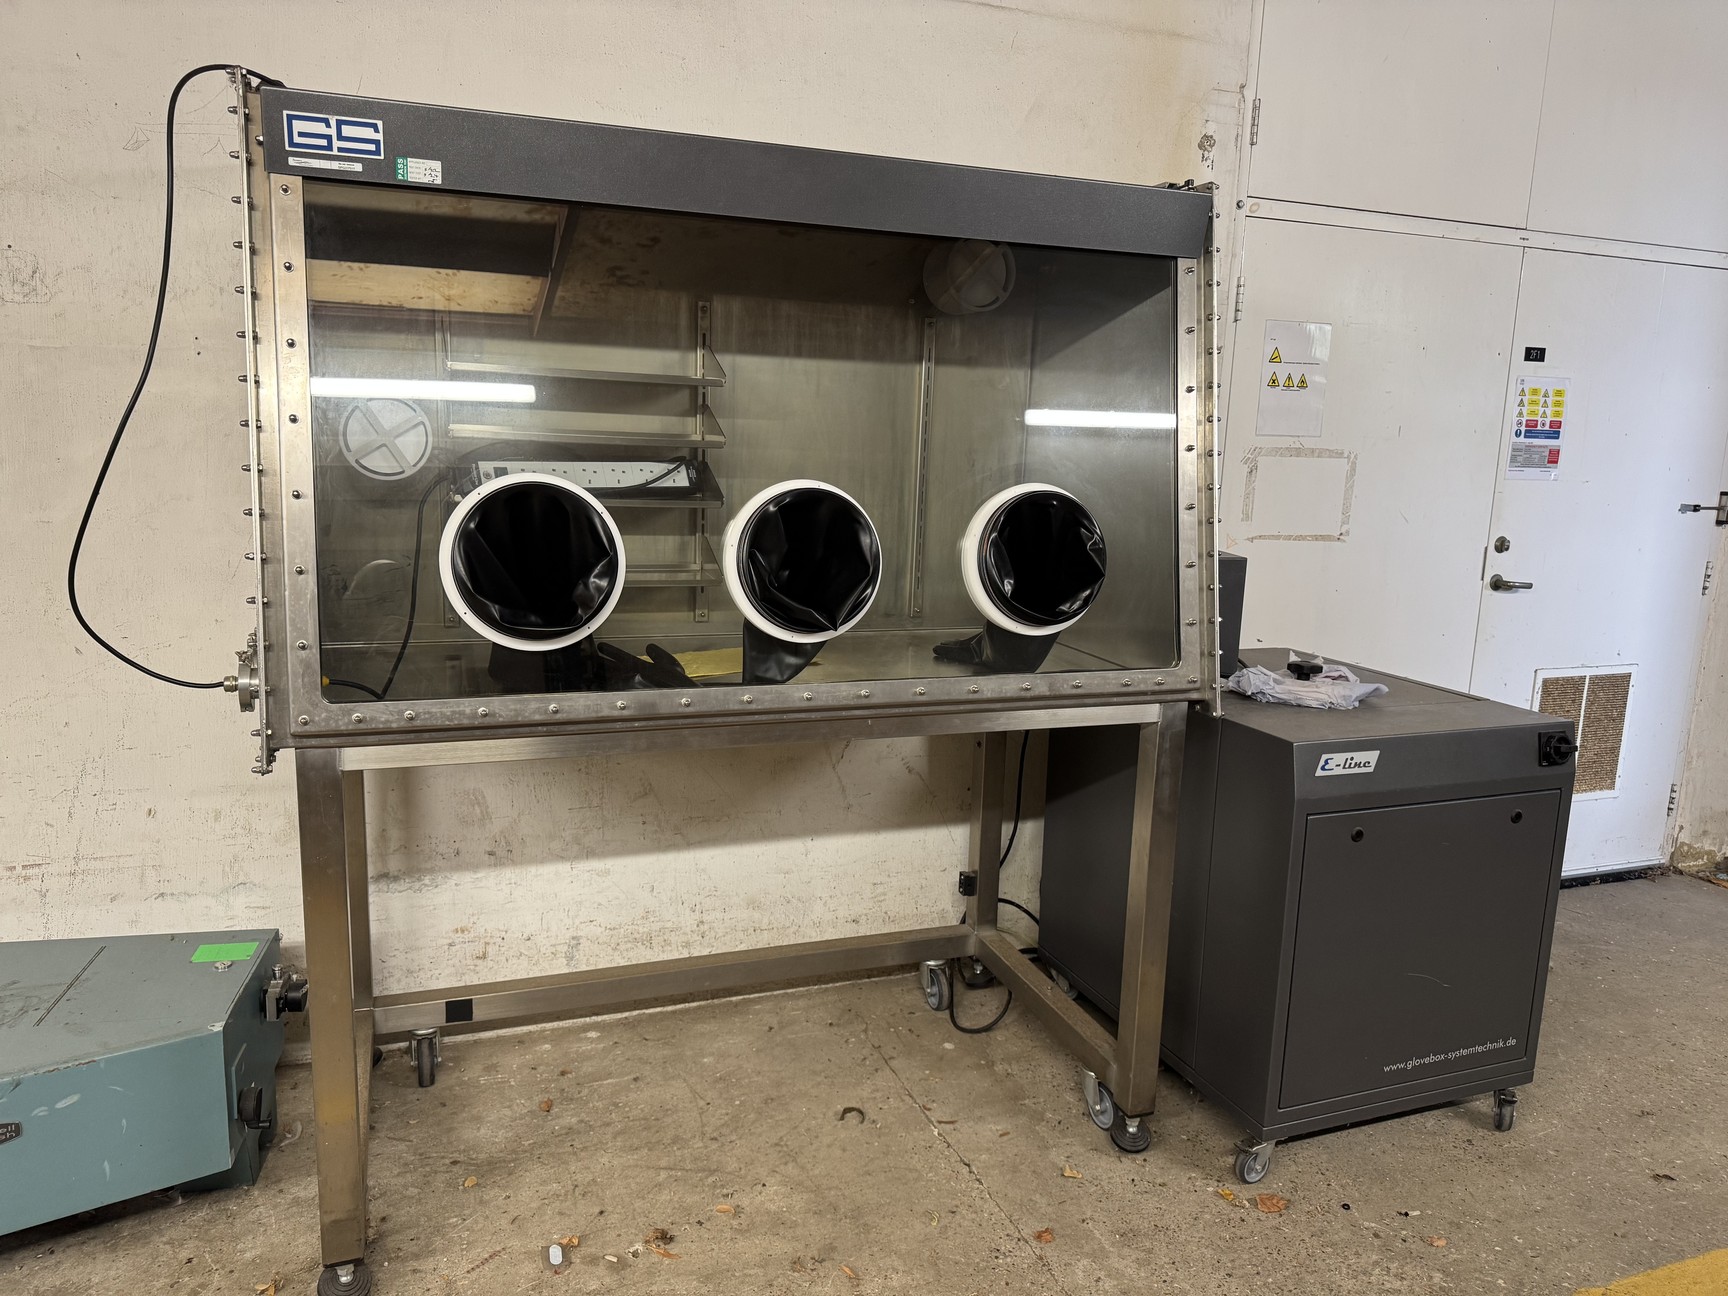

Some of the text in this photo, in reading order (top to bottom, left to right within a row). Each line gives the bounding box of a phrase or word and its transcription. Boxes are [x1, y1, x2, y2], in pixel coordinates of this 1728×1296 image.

[286, 113, 382, 157] GS
[1530, 349, 1541, 360] 2F1
[1320, 756, 1372, 772] E-line
[1383, 1036, 1517, 1073] www.glovebox-systemtechnik.de
